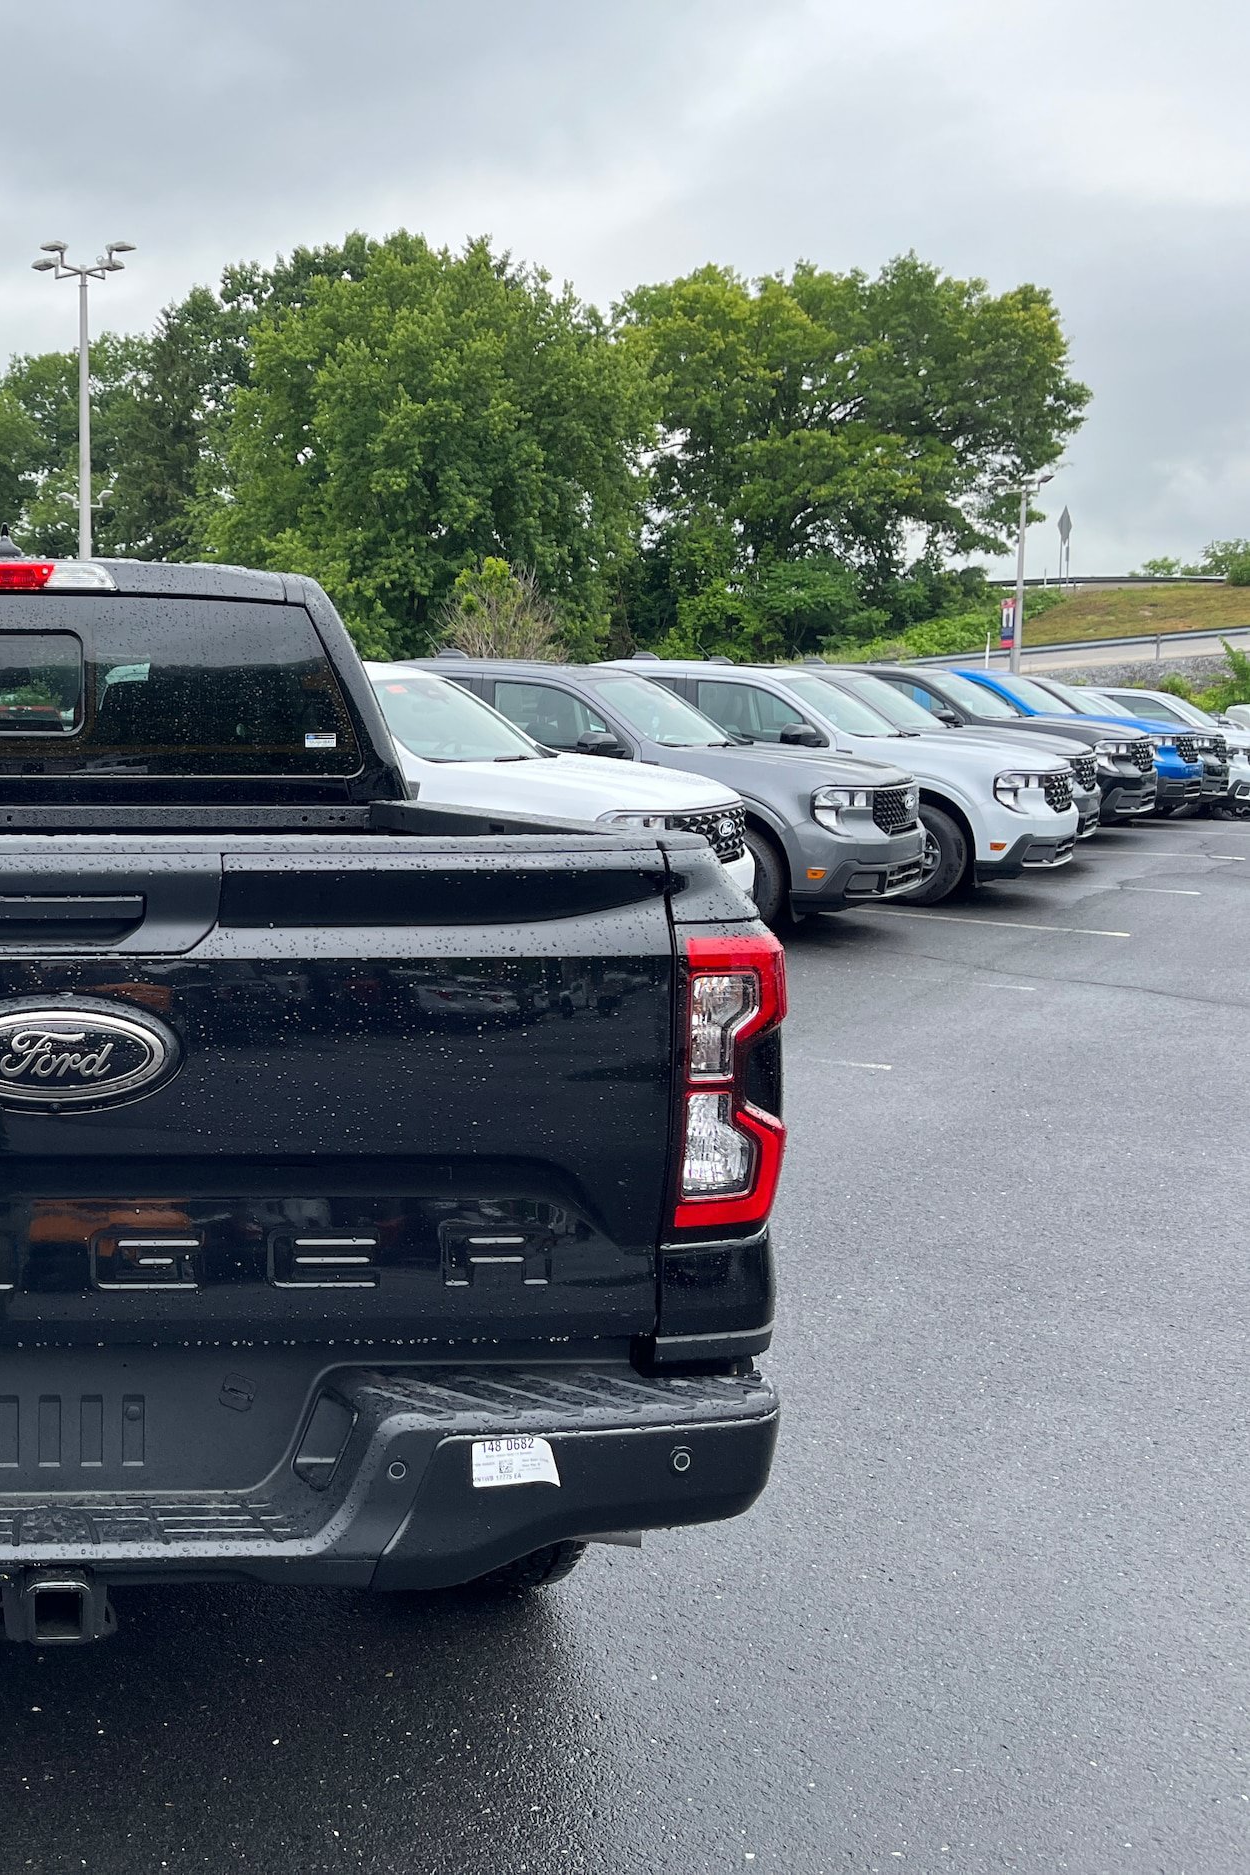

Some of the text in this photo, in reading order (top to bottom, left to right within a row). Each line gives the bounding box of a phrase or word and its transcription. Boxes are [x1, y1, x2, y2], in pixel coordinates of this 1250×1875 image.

[0, 1030, 114, 1078] Ford
[481, 1438, 535, 1454] 148 0682
